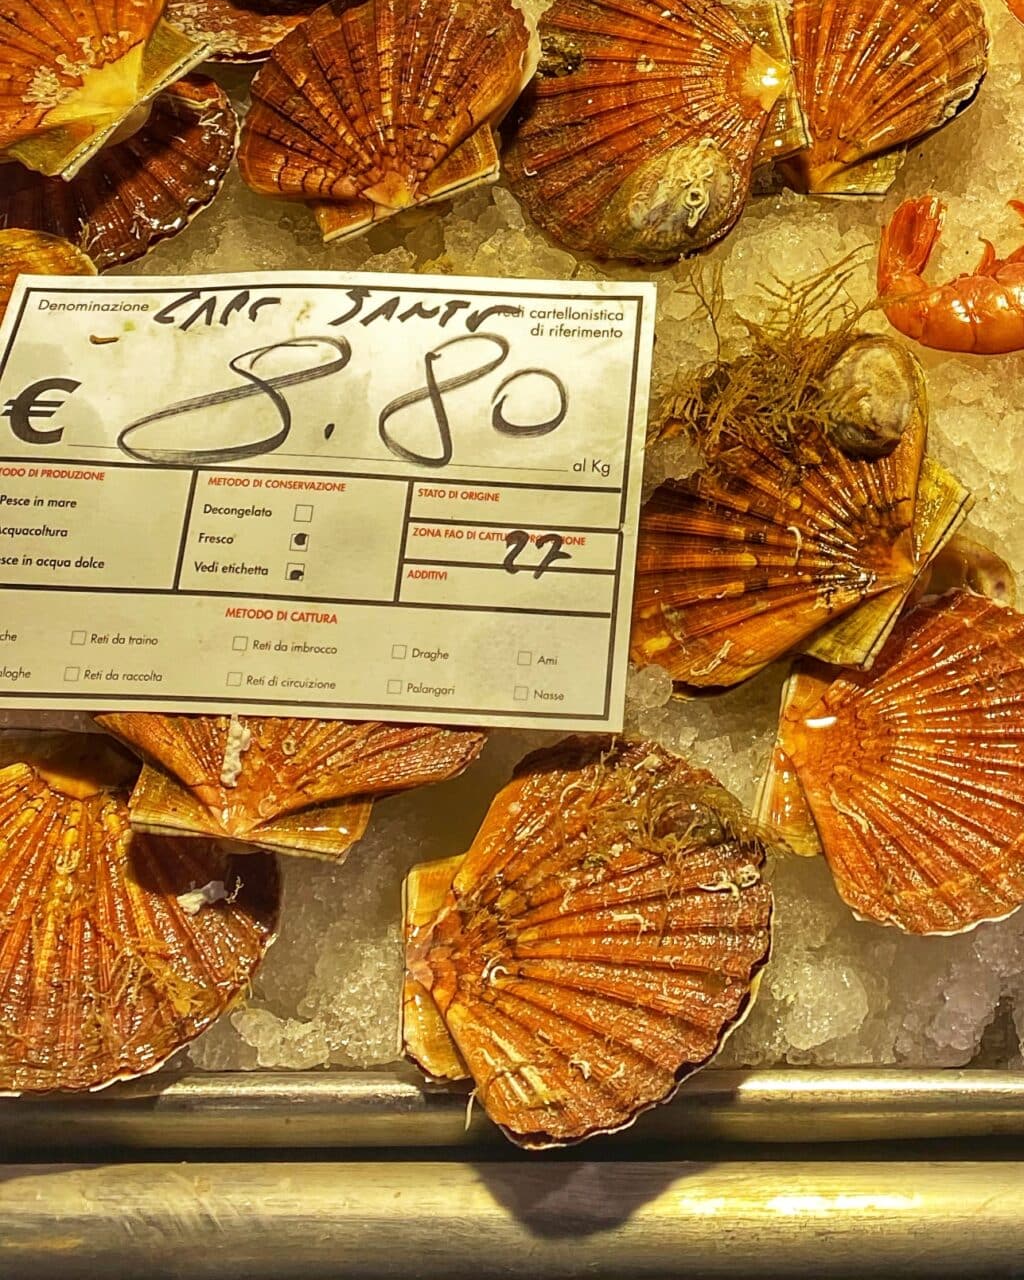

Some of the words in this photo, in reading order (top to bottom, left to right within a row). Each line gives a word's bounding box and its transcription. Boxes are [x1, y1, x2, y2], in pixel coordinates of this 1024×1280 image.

[38, 299, 149, 313] Denominazione
[529, 306, 624, 321] cartellonistica
[530, 324, 545, 337] di
[549, 324, 623, 339] riferimento
[1, 377, 82, 445] €
[117, 332, 568, 468] 8.80
[28, 468, 38, 477] DI
[41, 469, 105, 481] PRODUZIONE
[573, 458, 587, 473] al
[591, 459, 611, 477] Kg
[208, 477, 250, 487] METODO
[253, 479, 263, 488] DI
[265, 479, 346, 492] CONSERVAZIONE
[0, 495, 30, 507] Pesce
[34, 495, 44, 507] in
[47, 500, 77, 508] mare
[417, 488, 447, 499] STATO
[449, 490, 459, 500] DI
[461, 491, 500, 502] ORIGINE
[203, 504, 272, 519] Decongelato
[198, 533, 234, 545] Fresco
[412, 527, 442, 538] ZONA
[444, 529, 464, 539] FAO
[467, 531, 476, 540] DI
[22, 555, 32, 566] in
[36, 558, 71, 570] acqua
[75, 556, 105, 569] dolce
[194, 561, 218, 573] Vedi
[221, 562, 269, 576] etichetta
[407, 569, 448, 581] ADDITIVI
[225, 608, 274, 620] METODO
[277, 610, 288, 621] DI
[291, 611, 338, 624] CATTURA
[90, 633, 109, 645] Reti
[112, 633, 126, 645] da
[128, 634, 159, 646] traino
[252, 639, 271, 651] Reti
[274, 640, 288, 652] da
[291, 642, 338, 655] imbrocco
[411, 647, 449, 662] Draghe
[537, 655, 558, 666] Ami
[83, 669, 102, 681] Reti
[105, 669, 119, 681] da
[122, 671, 163, 682] raccolta
[246, 674, 265, 686] Reti
[268, 675, 278, 687] di
[281, 677, 336, 690] circuizione
[406, 682, 456, 698] Palangari
[533, 689, 565, 701] Nasse
